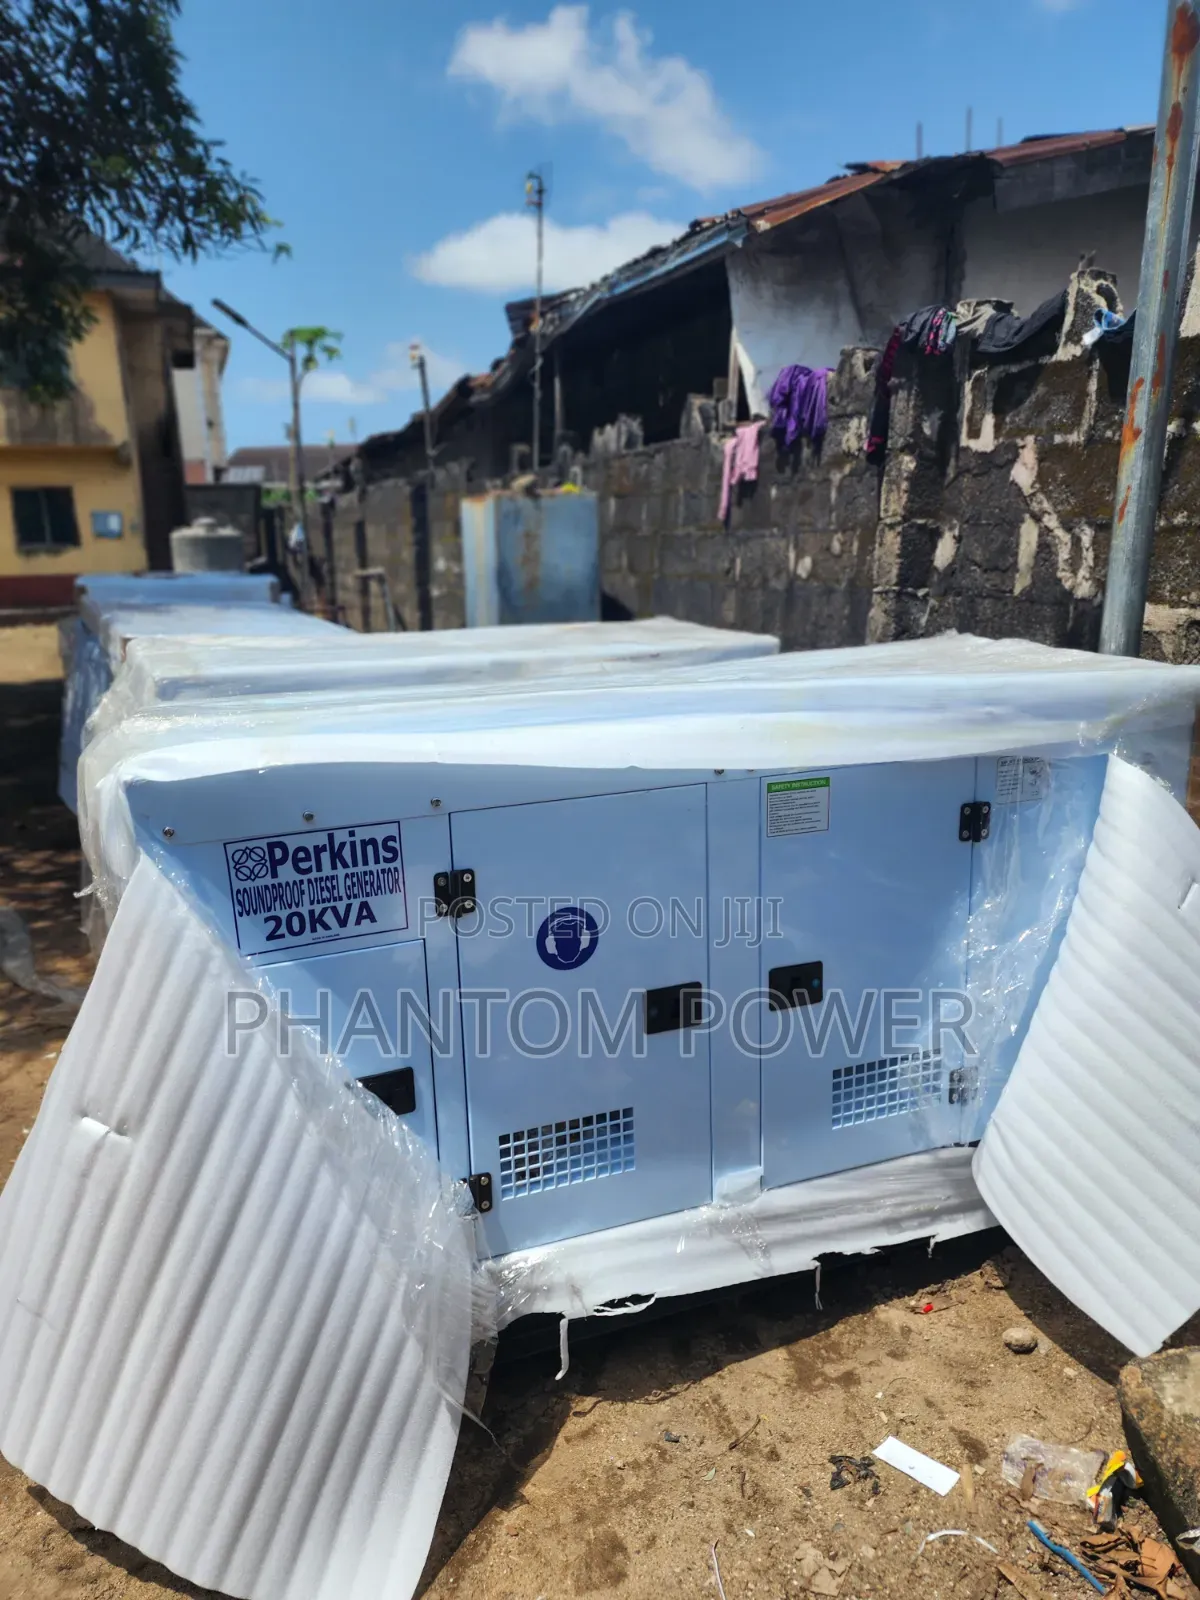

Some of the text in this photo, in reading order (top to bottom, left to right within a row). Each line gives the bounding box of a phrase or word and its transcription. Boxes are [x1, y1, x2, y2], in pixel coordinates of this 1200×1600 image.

[771, 780, 826, 791] SAFETY INSTRUCTION
[266, 830, 399, 879] Perkins
[235, 867, 402, 917] SOUNDPROOF DIESEL GENERATOR
[263, 901, 378, 942] 20KVA
